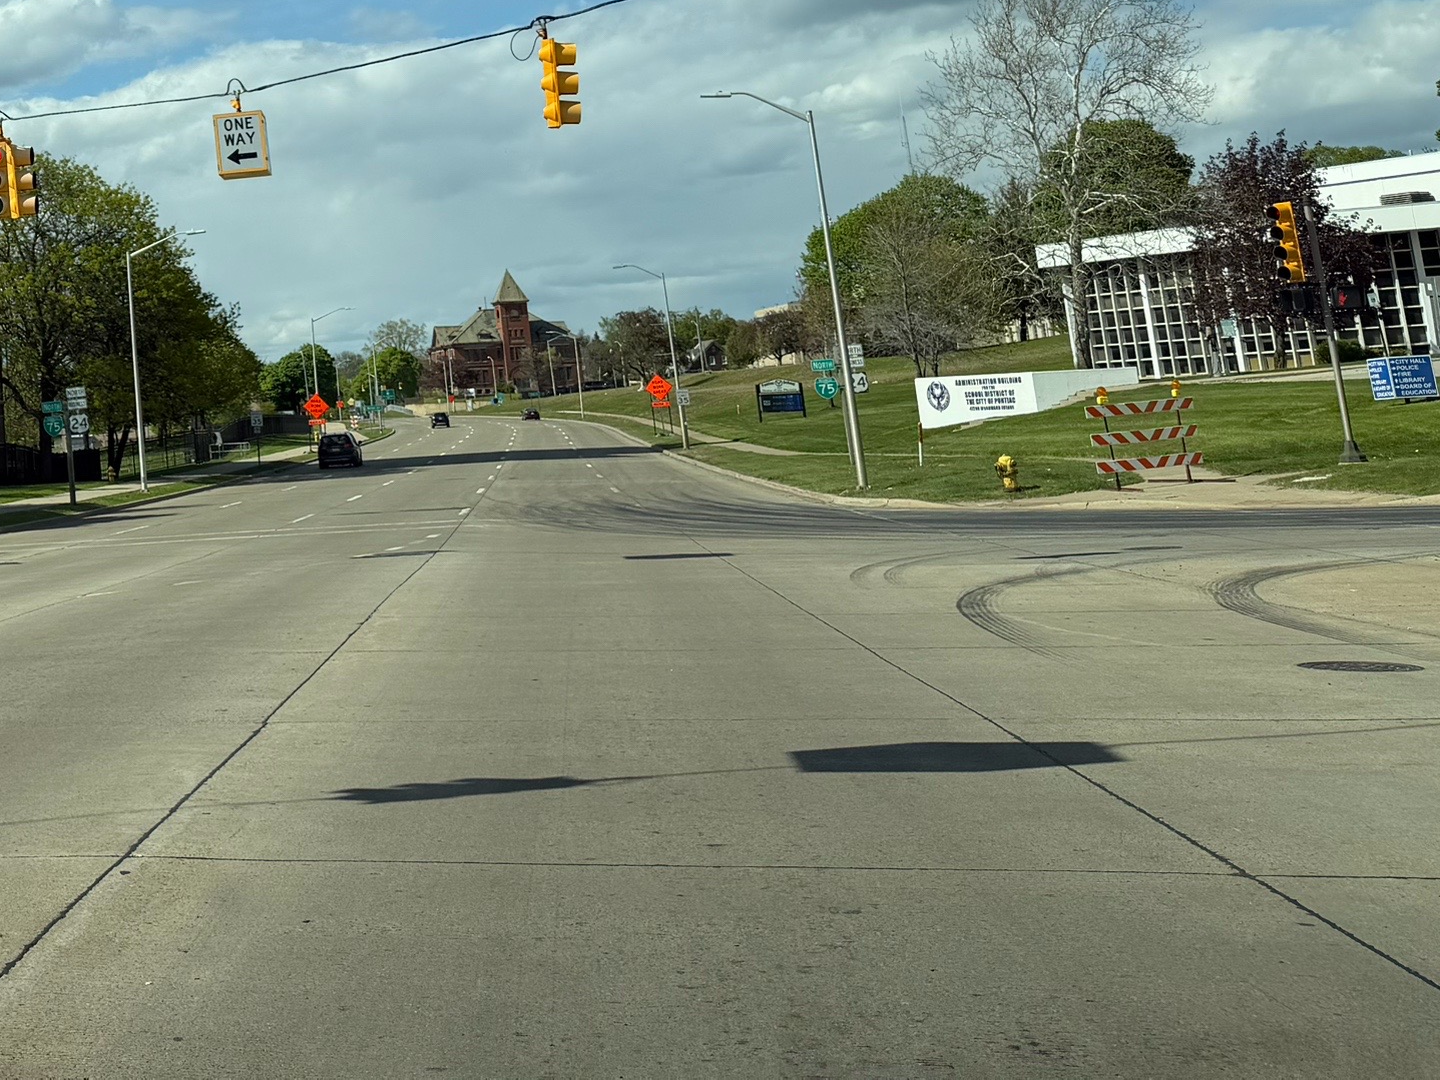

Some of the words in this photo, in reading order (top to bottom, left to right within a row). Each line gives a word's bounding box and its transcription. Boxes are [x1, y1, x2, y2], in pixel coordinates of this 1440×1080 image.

[224, 117, 254, 131] ONE
[224, 132, 255, 146] WAY
[955, 378, 996, 386] ADMINISTRATION
[819, 384, 835, 394] 75
[47, 422, 60, 433] 75
[71, 417, 88, 429] 24
